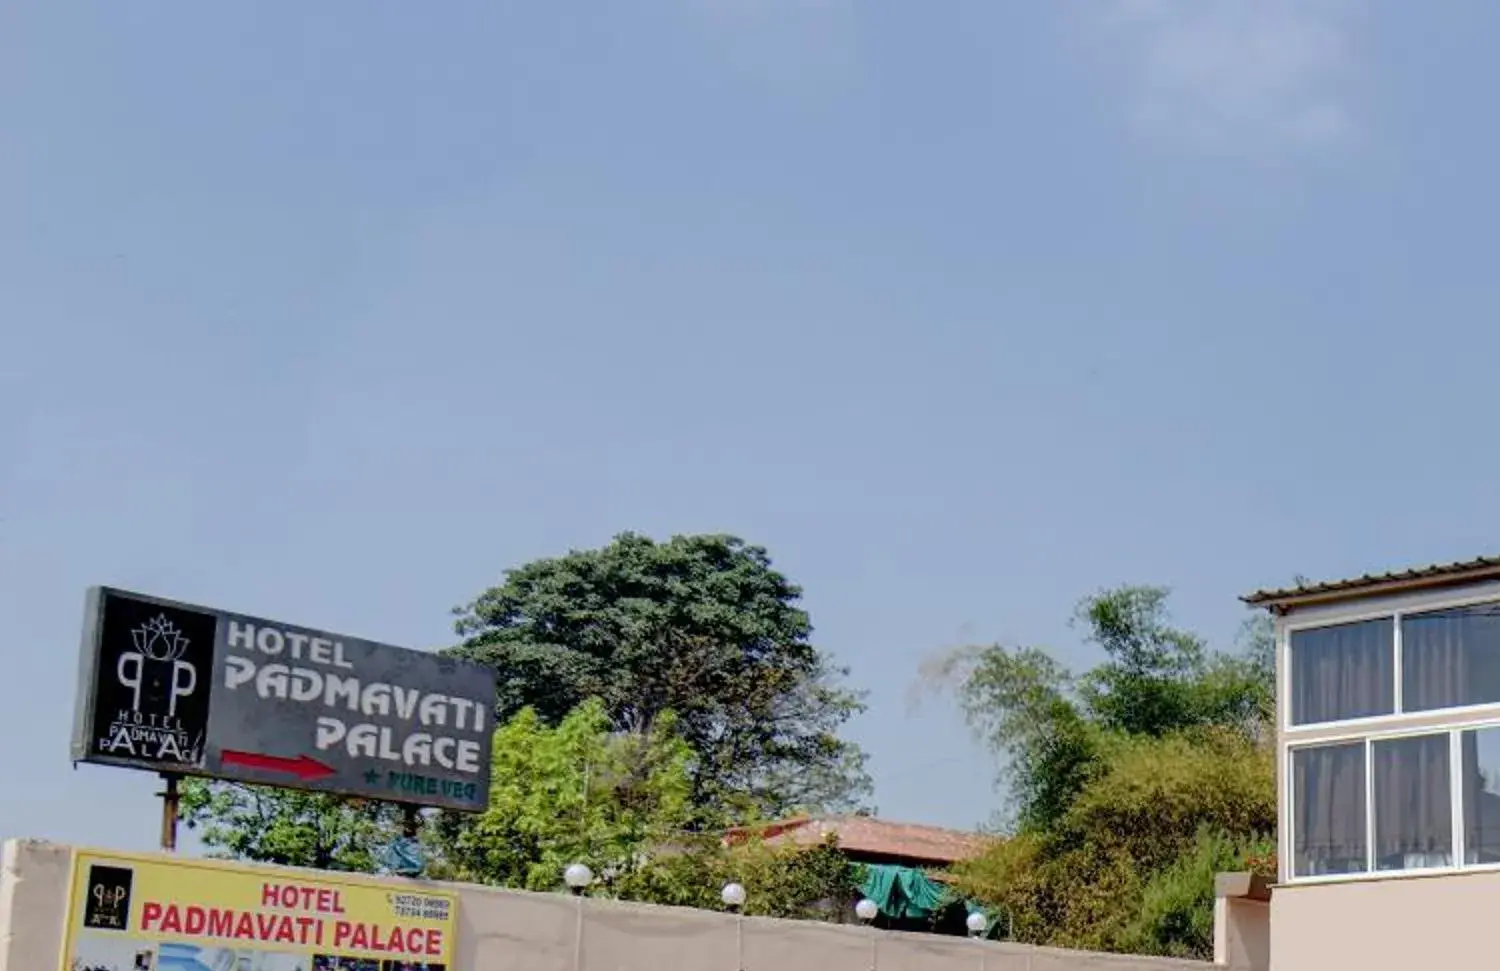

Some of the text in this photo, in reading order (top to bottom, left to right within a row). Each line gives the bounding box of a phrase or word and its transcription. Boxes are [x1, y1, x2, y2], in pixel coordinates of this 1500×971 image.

[228, 621, 353, 668] HOTEL
[223, 655, 485, 733] PADMAVATI
[118, 709, 184, 731] HOTEL
[315, 717, 481, 773] PALACE
[387, 770, 477, 800] PURE VEG
[261, 883, 346, 914] HOTEL
[140, 902, 324, 947] PADMAVATI
[334, 922, 442, 955] PALACE
